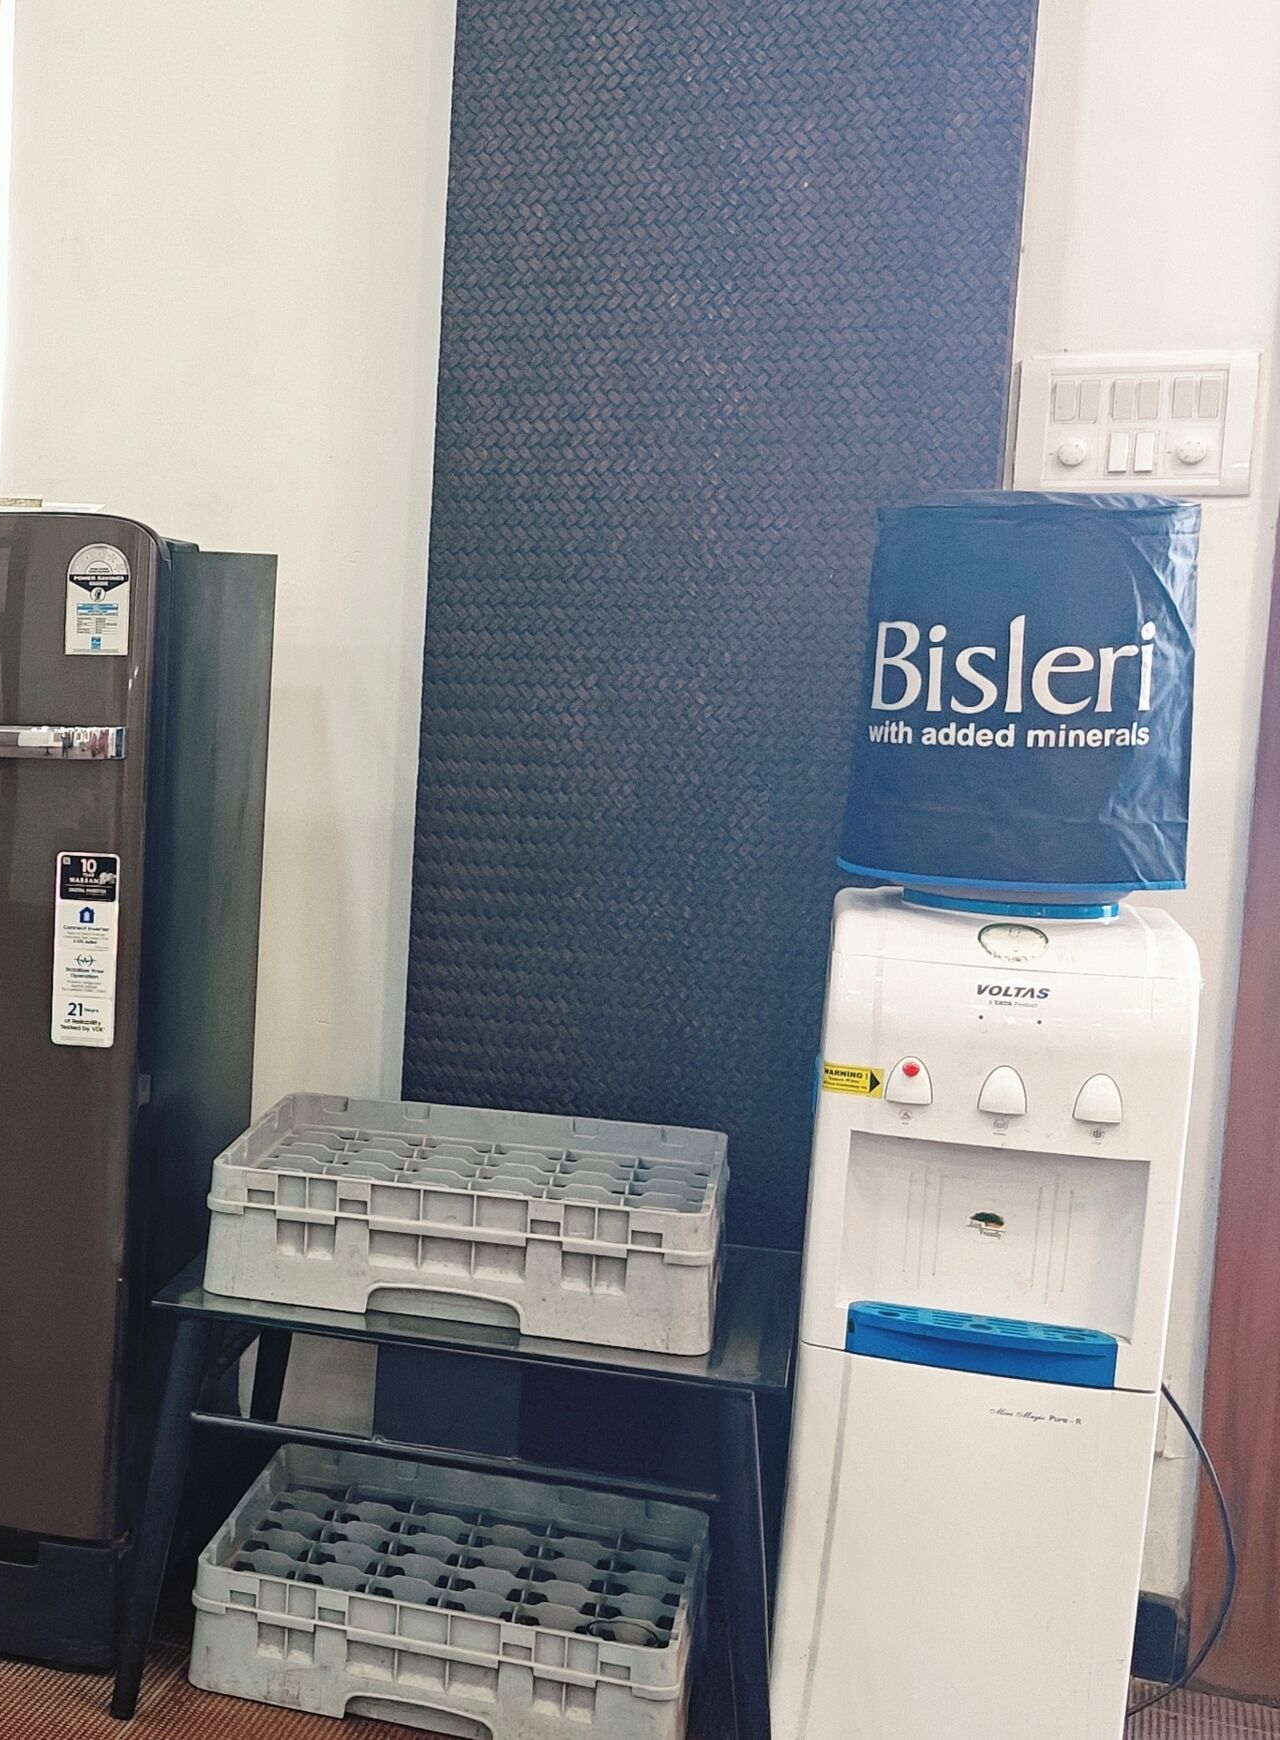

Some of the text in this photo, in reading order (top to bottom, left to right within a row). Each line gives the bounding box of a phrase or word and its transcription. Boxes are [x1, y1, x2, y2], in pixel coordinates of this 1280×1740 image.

[871, 614, 1156, 715] Bisleri
[869, 720, 1151, 748] with added minerals
[80, 858, 98, 873] 10
[976, 984, 1050, 999] VOLTAS
[67, 1002, 83, 1017] 21
